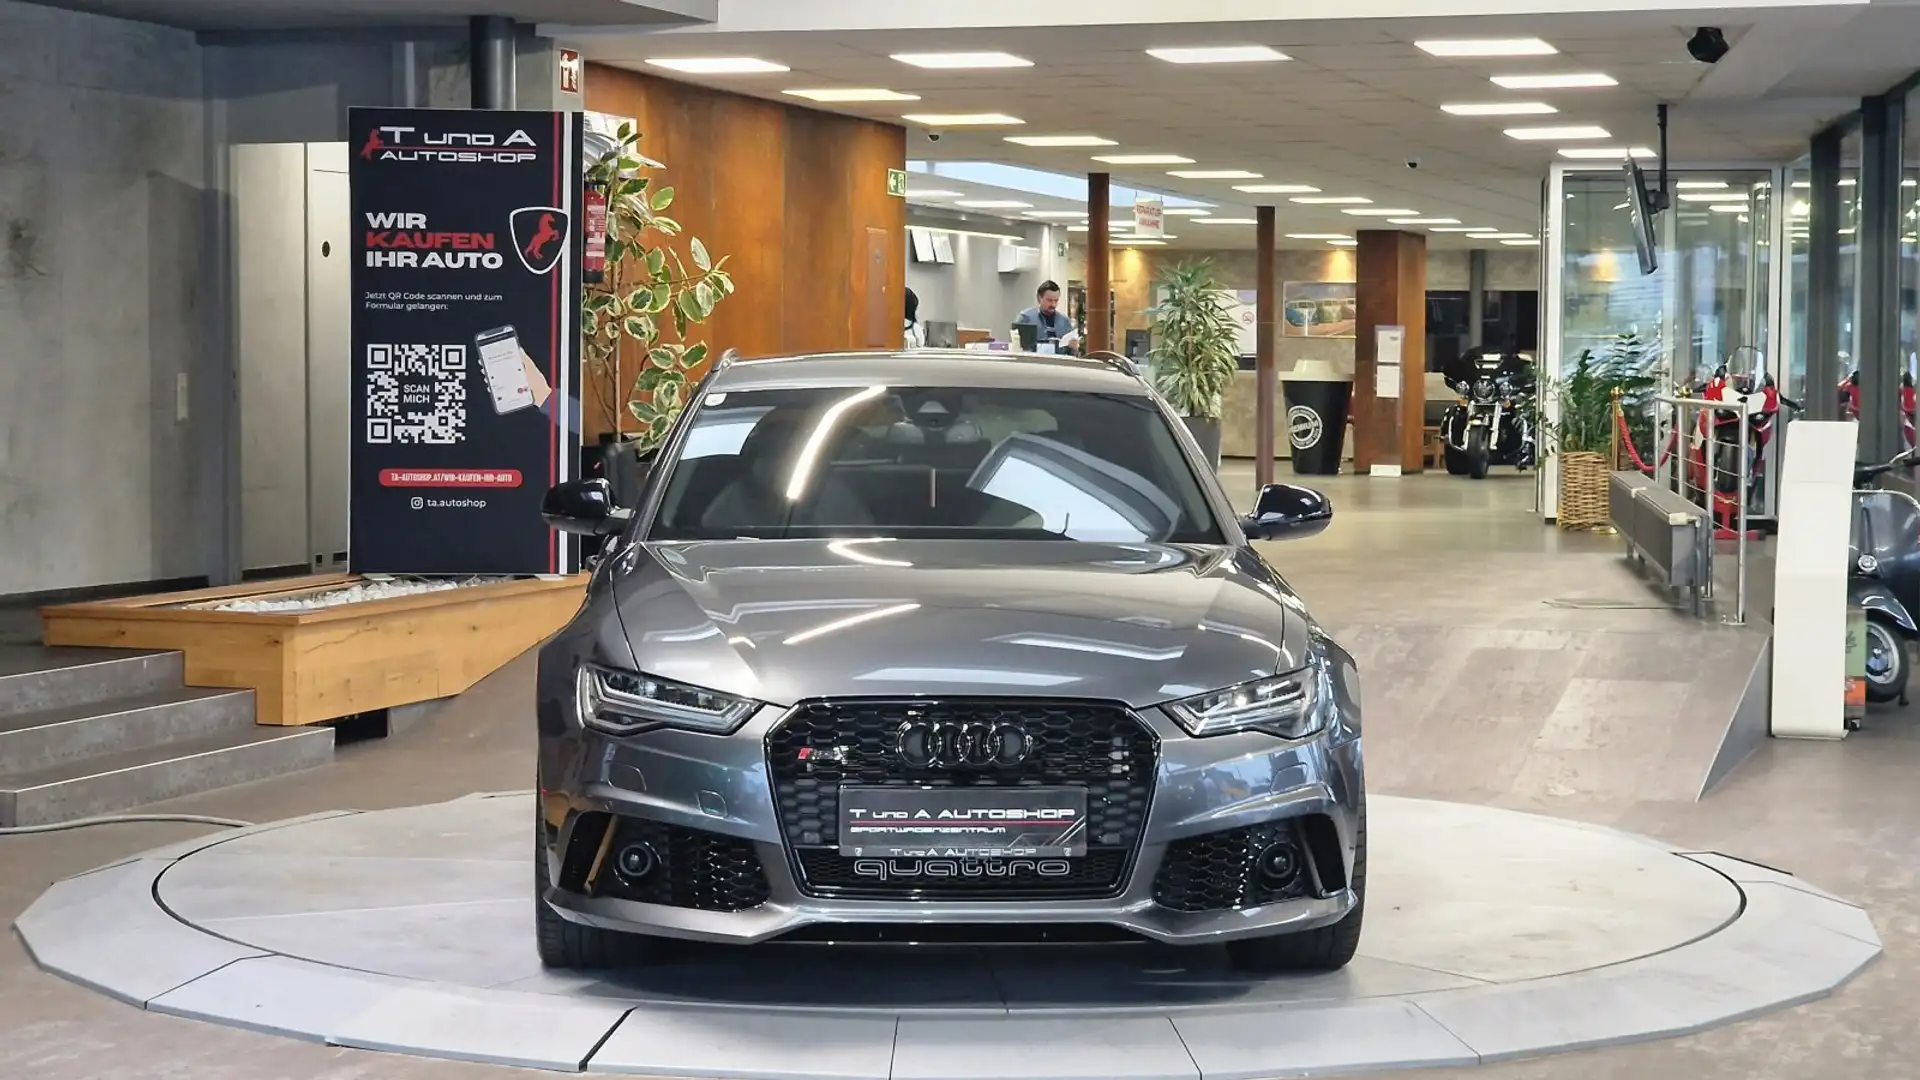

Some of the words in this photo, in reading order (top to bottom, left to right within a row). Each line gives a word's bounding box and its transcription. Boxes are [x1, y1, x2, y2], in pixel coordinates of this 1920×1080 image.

[379, 126, 415, 144] T
[502, 129, 537, 147] A
[380, 150, 537, 163] AUTOSHOP
[365, 212, 427, 229] WIR
[366, 231, 495, 249] KAUFEN
[366, 251, 418, 268] IHR
[421, 252, 503, 269] AUTO
[365, 291, 386, 299] Jetzt
[388, 291, 401, 300] QR
[403, 292, 425, 300] Code
[427, 293, 463, 301] scannen
[465, 293, 482, 301] und
[365, 302, 404, 310] Formular
[406, 302, 448, 312] gelangen:
[403, 384, 430, 394] SCAN
[403, 394, 430, 404] MICH
[427, 498, 487, 509] ta.autoshop
[849, 808, 867, 819] T
[914, 808, 932, 819] A
[938, 808, 1076, 819] AUTOSHOP
[944, 847, 1036, 857] AUTOSHOP
[854, 856, 1071, 881] quattro
